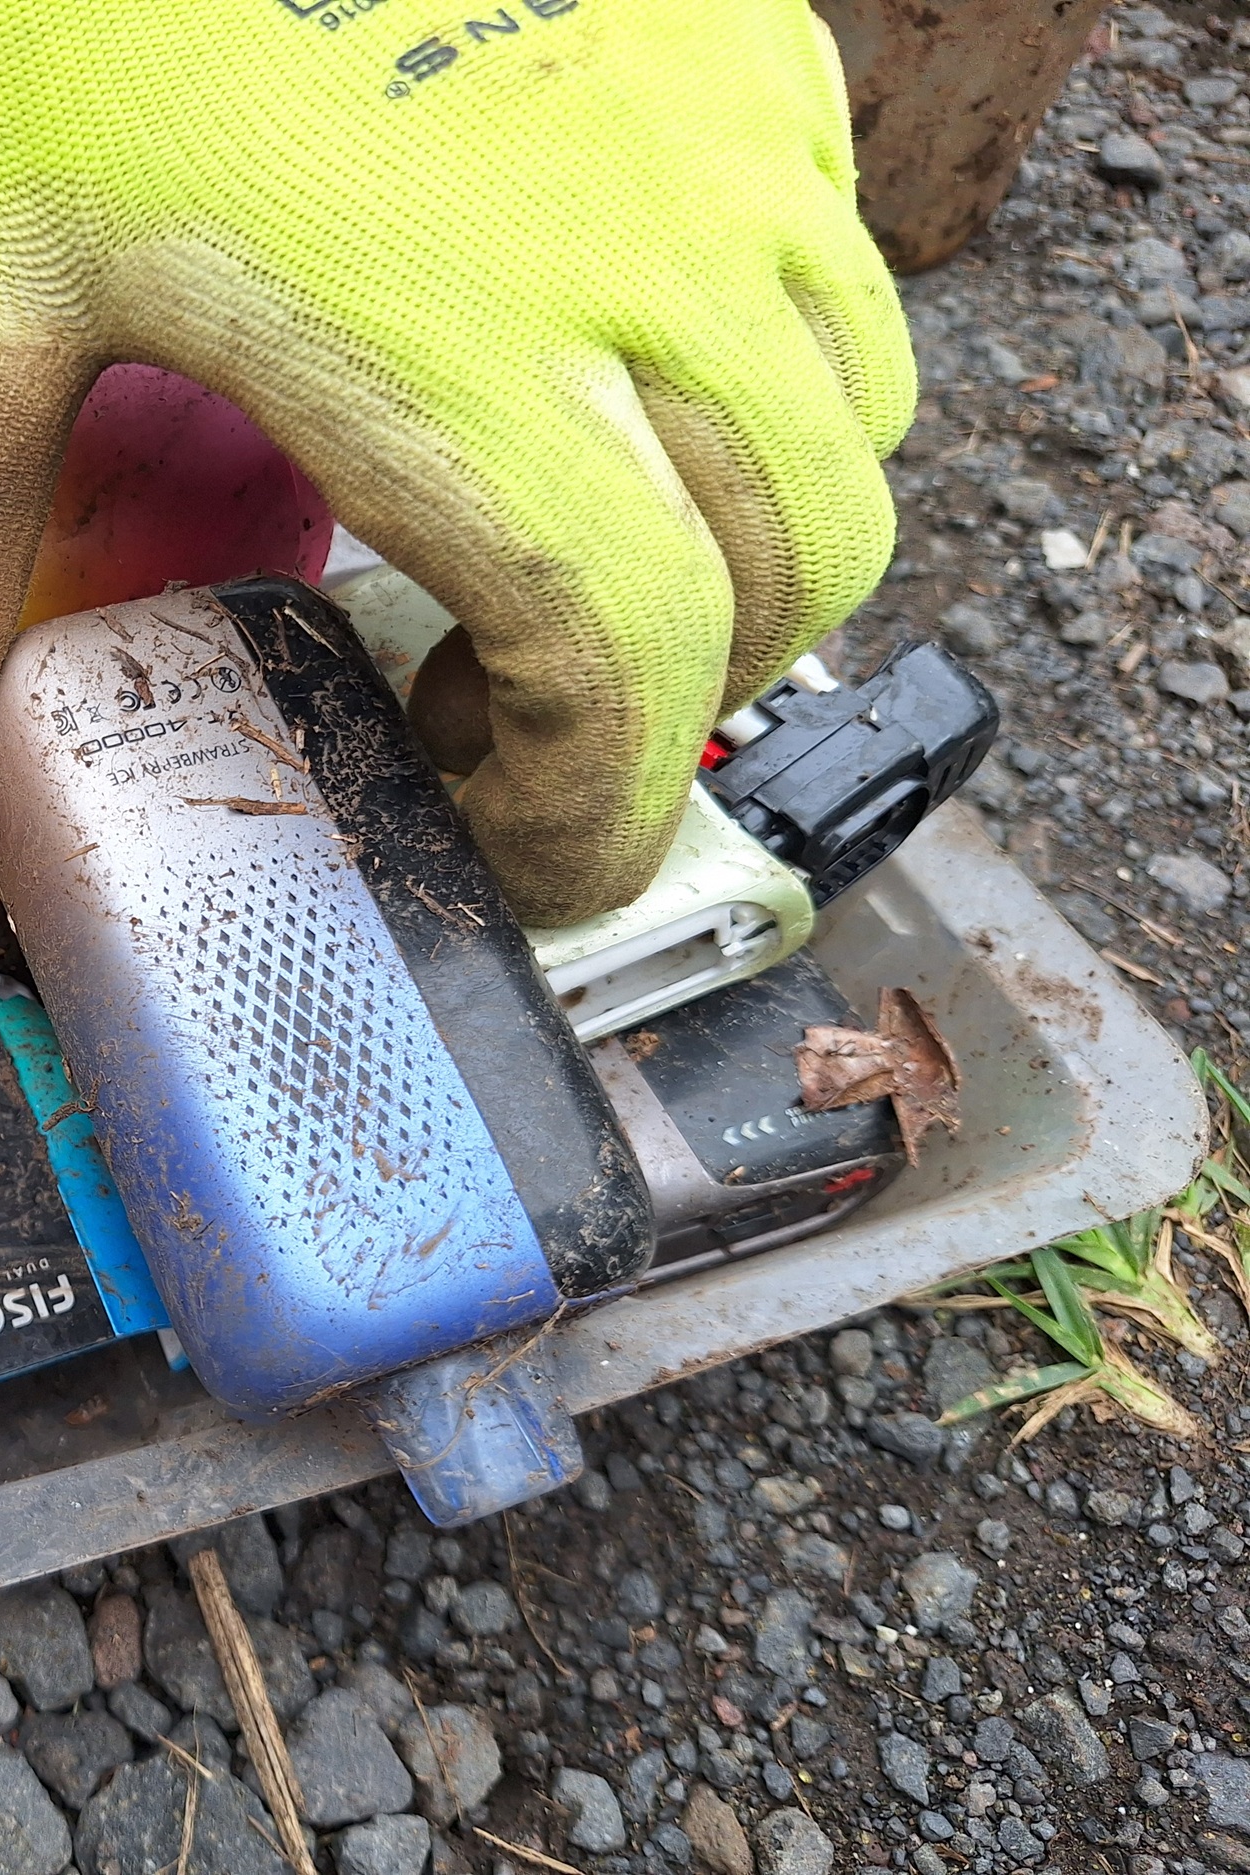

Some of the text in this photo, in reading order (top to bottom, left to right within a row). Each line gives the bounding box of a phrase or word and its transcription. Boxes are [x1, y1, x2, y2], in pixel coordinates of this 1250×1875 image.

[319, 0, 386, 31] 016
[106, 738, 250, 786] STRAWBERRY ICE
[5, 1257, 50, 1281] DUAL
